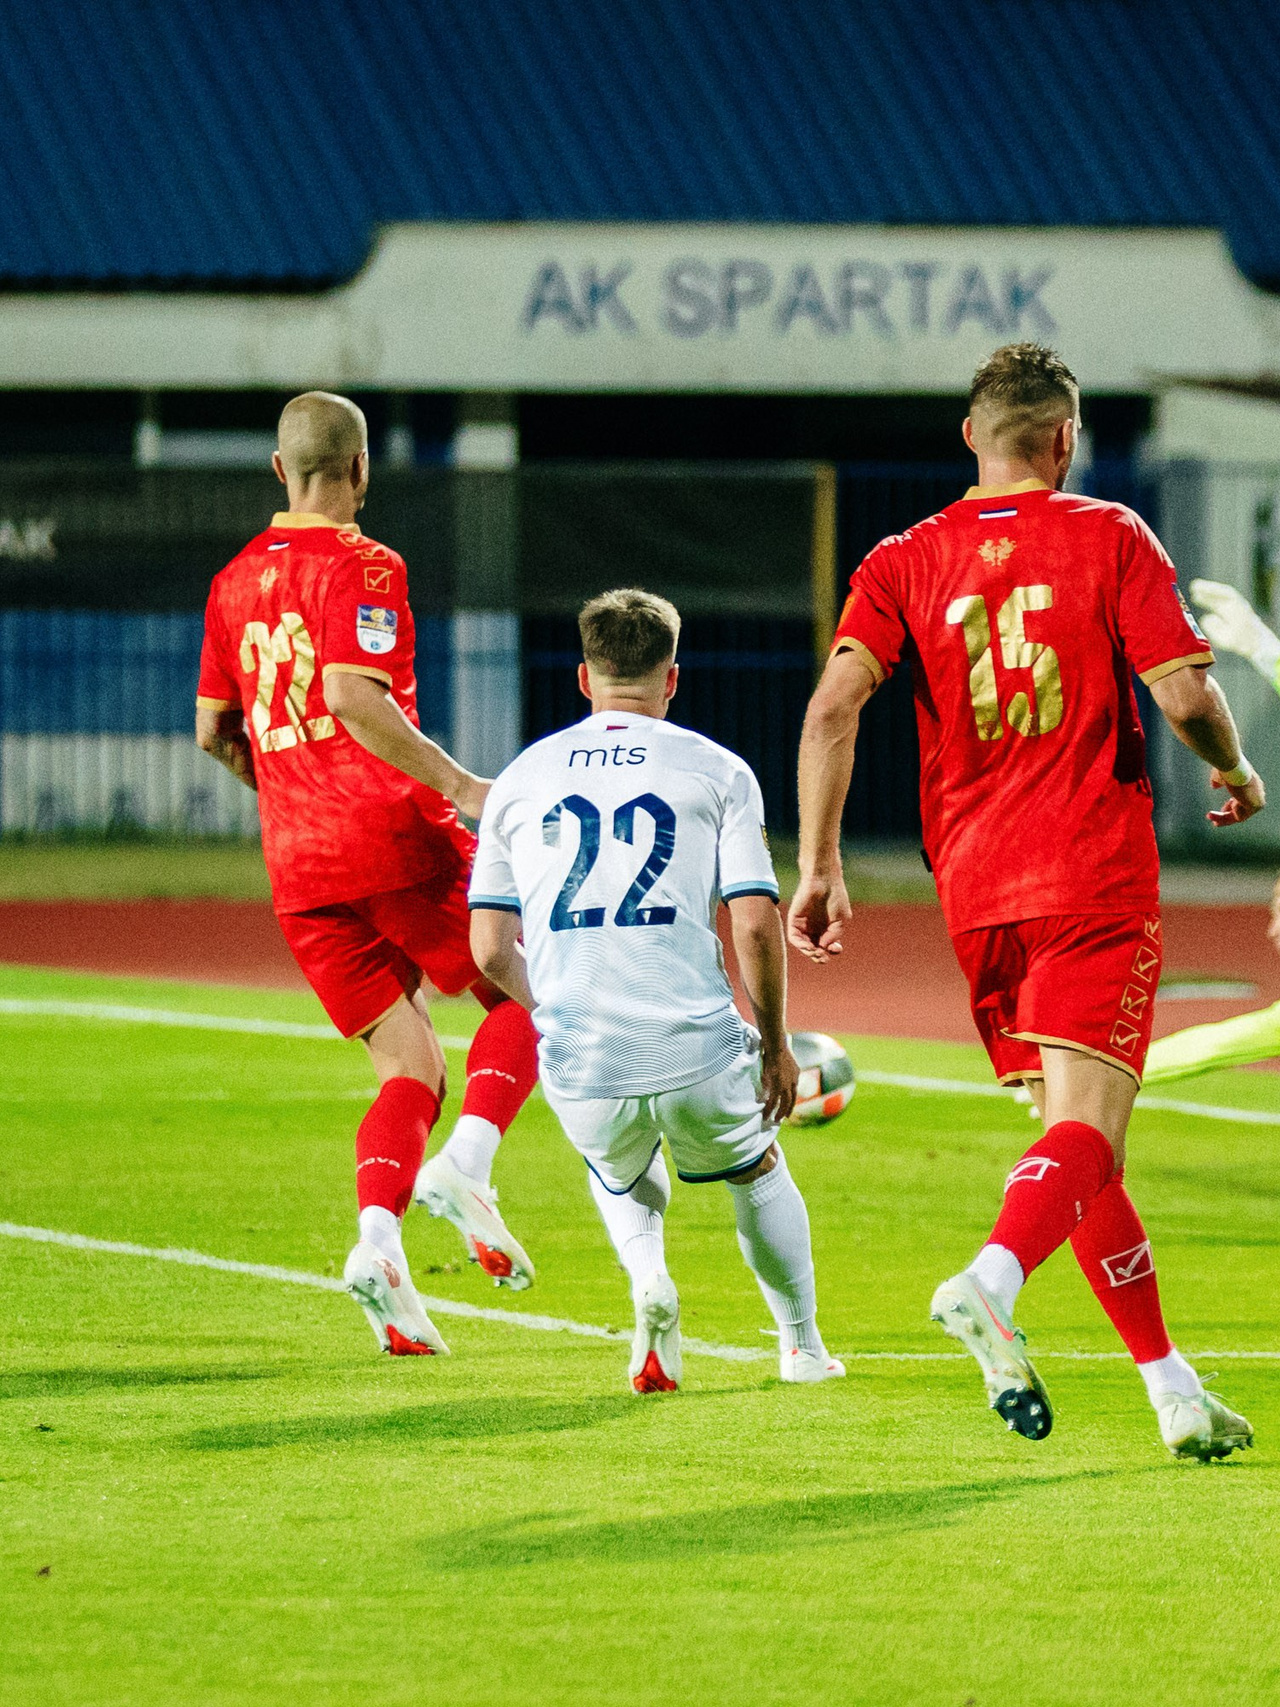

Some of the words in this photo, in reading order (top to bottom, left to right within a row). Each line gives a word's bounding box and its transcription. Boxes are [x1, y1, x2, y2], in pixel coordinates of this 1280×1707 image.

[521, 259, 638, 337] AK
[659, 257, 1060, 338] SPARTAK
[239, 612, 337, 754] 22
[945, 584, 1064, 742] 15
[568, 744, 648, 767] mts
[542, 792, 677, 932] 22
